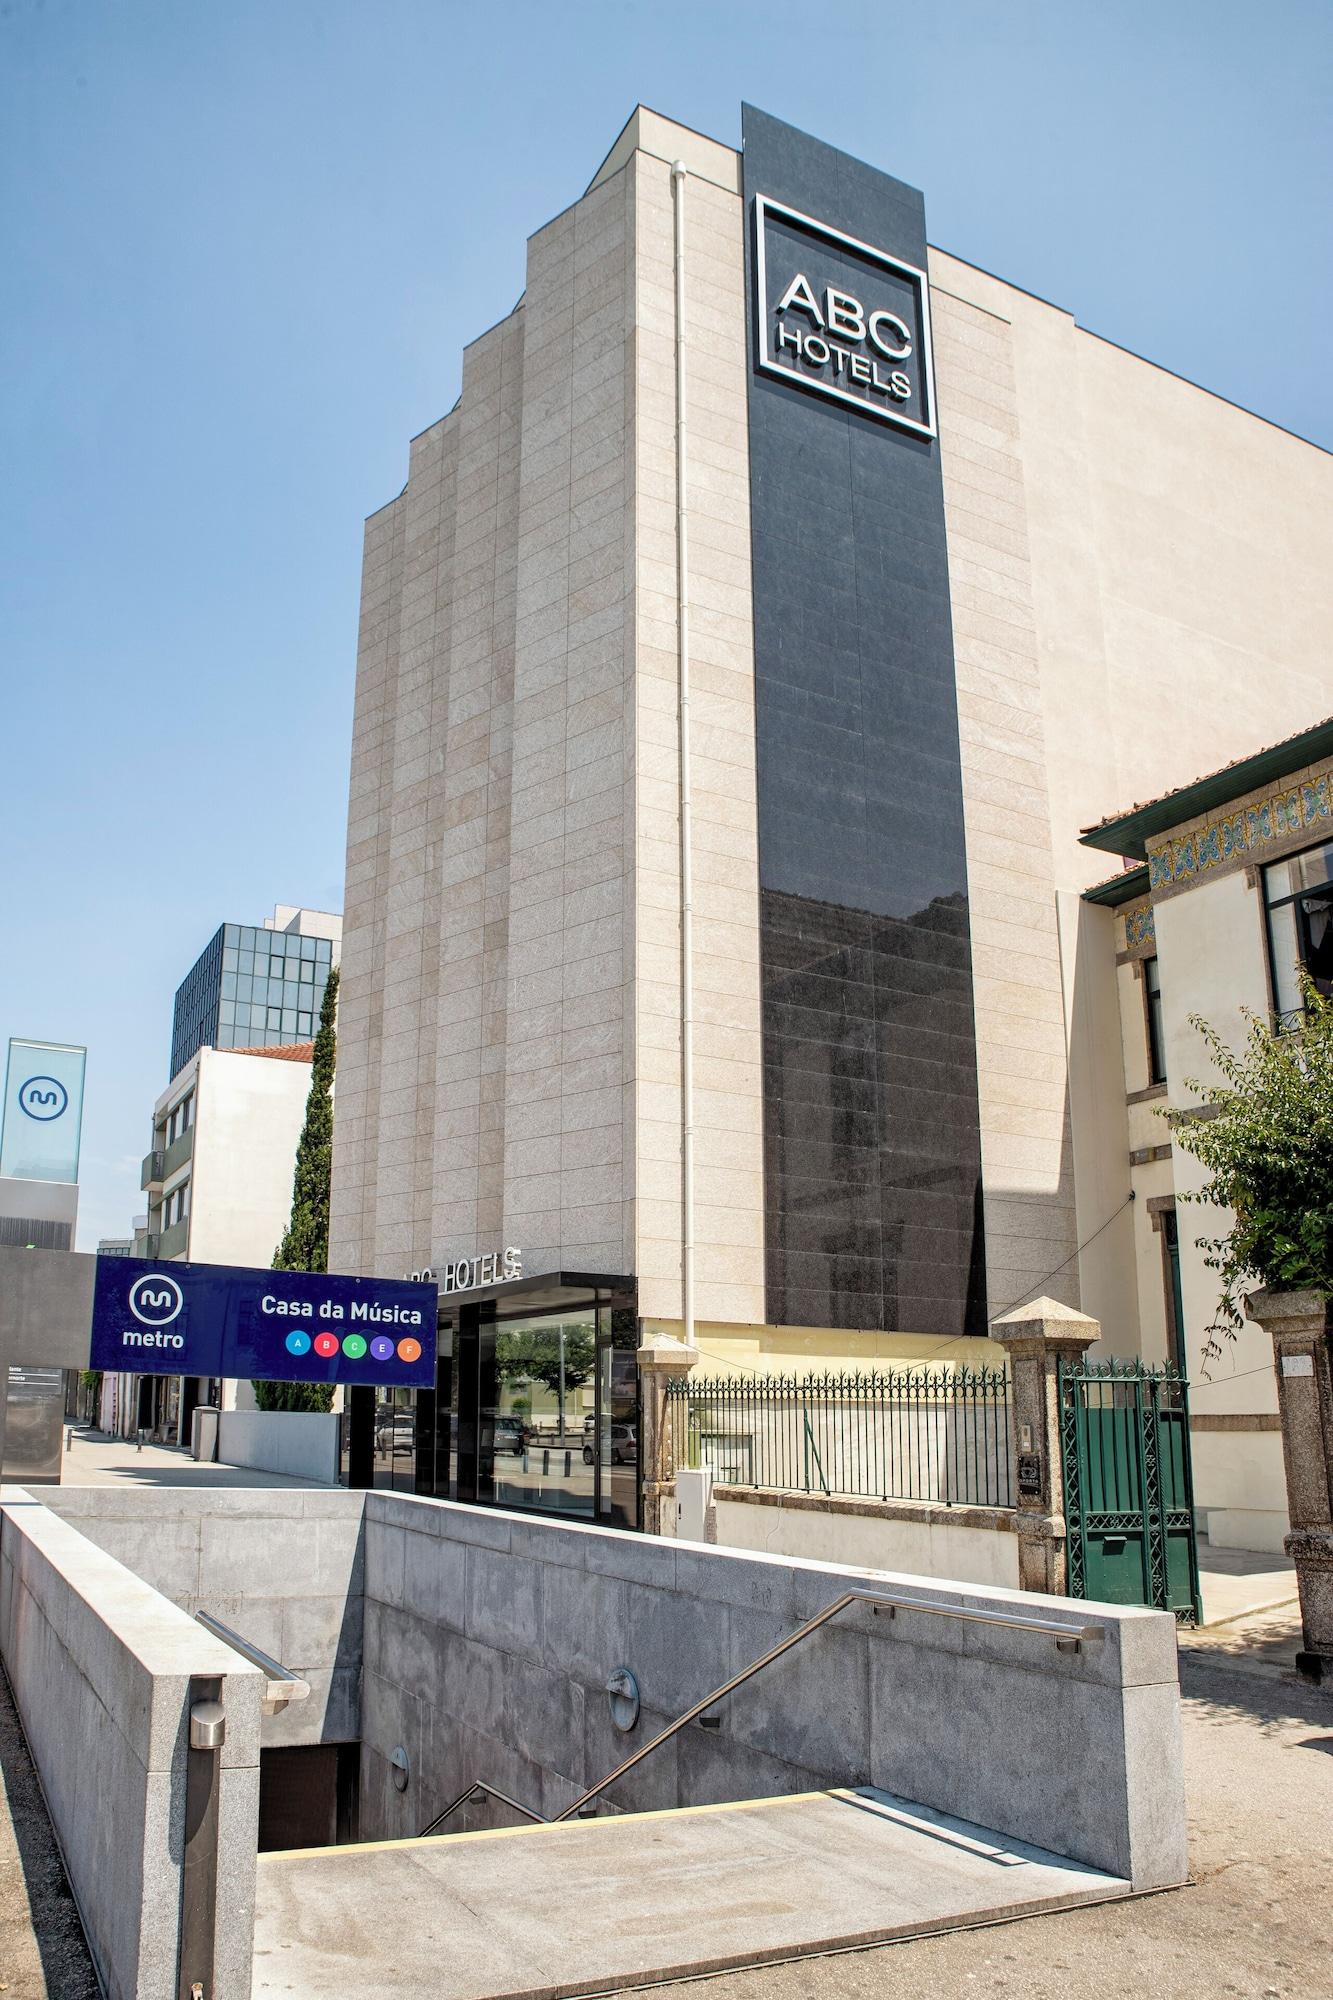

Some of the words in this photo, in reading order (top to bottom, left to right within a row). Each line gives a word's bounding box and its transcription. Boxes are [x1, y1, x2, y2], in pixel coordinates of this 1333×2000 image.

[779, 273, 912, 360] ABC
[779, 321, 912, 399] HOTELS
[444, 1246, 522, 1292] HOTELS
[261, 1295, 313, 1317] Casa
[319, 1300, 344, 1319] da
[351, 1302, 422, 1325] Música
[122, 1330, 184, 1349] metro
